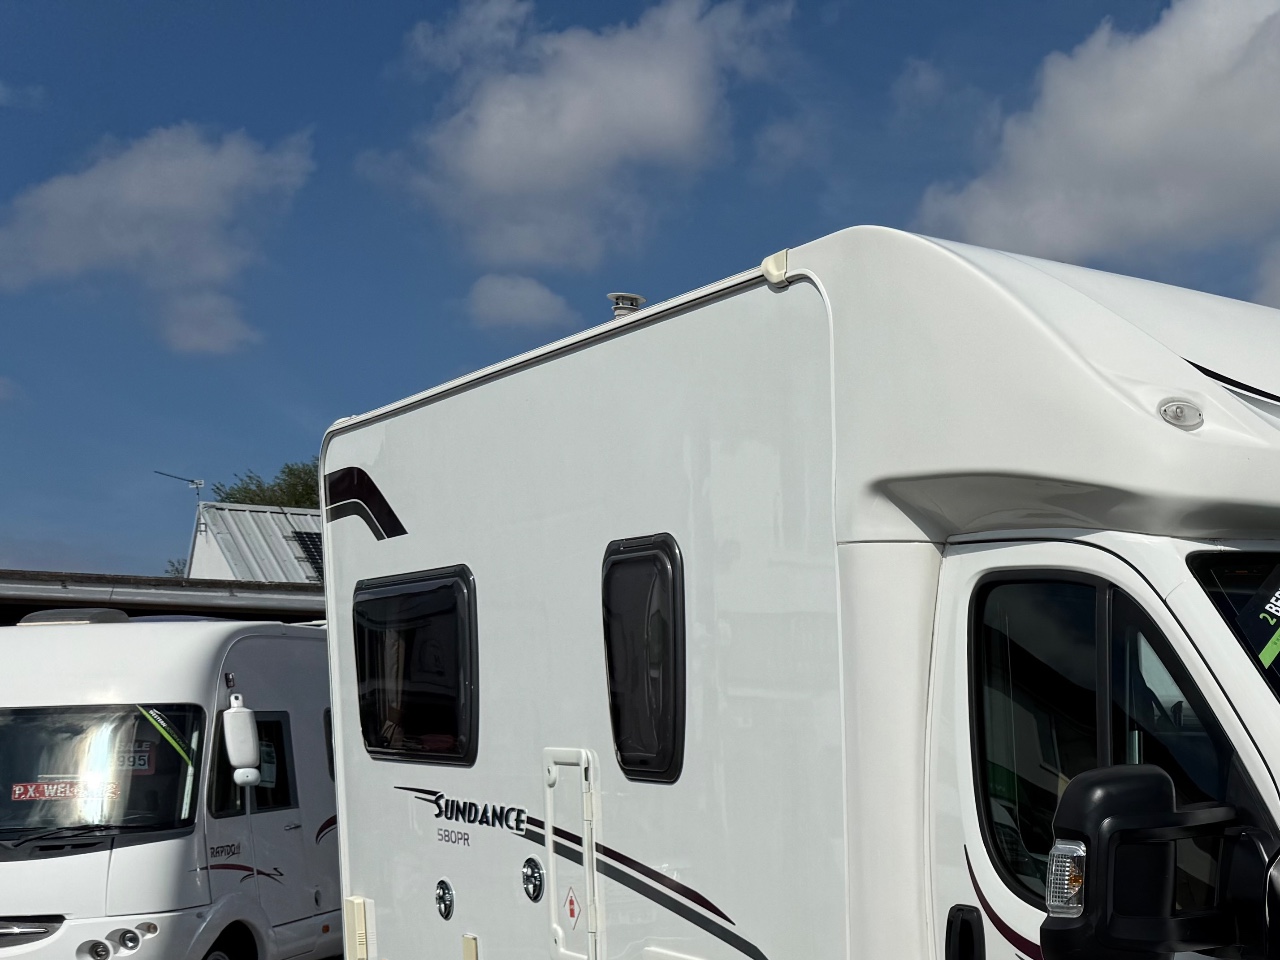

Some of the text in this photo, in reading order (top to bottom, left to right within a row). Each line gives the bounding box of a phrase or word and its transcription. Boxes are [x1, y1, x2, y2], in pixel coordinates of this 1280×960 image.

[1259, 612, 1277, 626] 2
[434, 793, 527, 832] SUNDANCE
[437, 828, 471, 847] 580PR
[210, 843, 236, 858] RAPIDO
